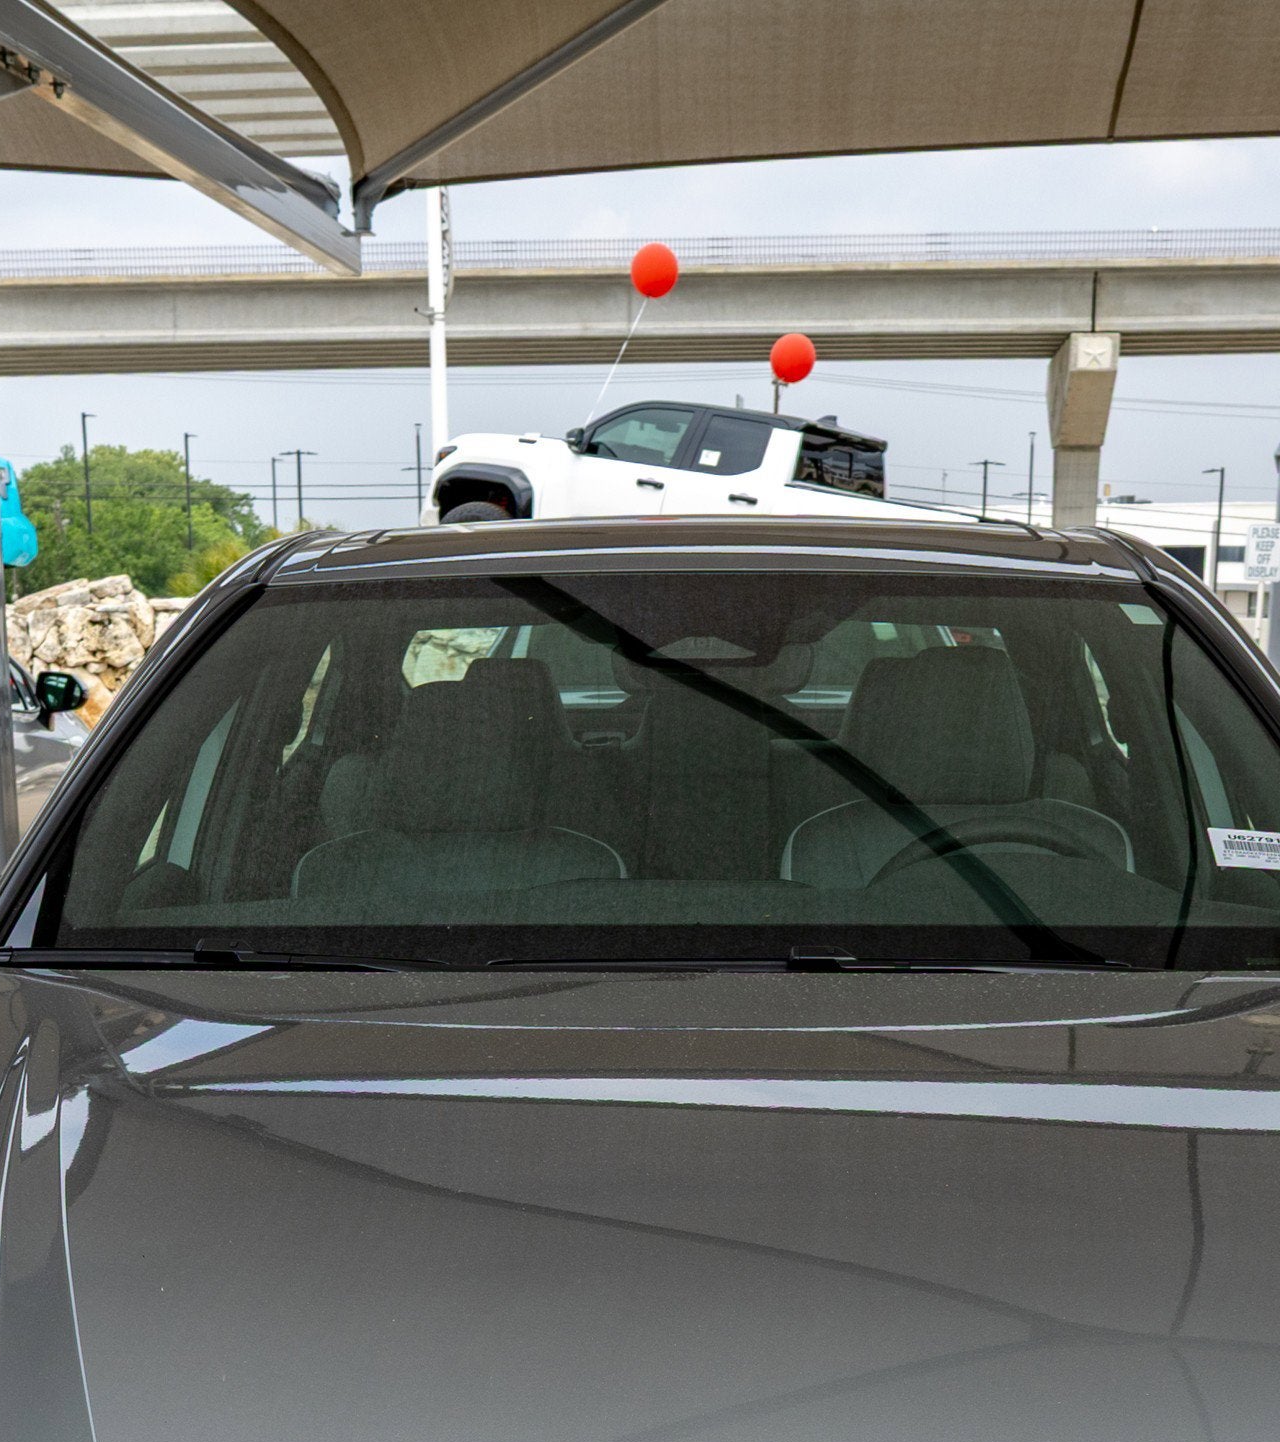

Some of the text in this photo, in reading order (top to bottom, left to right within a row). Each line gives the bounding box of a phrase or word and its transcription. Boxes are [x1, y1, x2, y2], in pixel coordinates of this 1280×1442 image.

[1252, 527, 1280, 539] PLEASE
[1255, 540, 1276, 552] KEEP
[1256, 553, 1271, 565] OFF
[1247, 566, 1279, 578] DISPLAY
[1227, 833, 1280, 844] U62791
